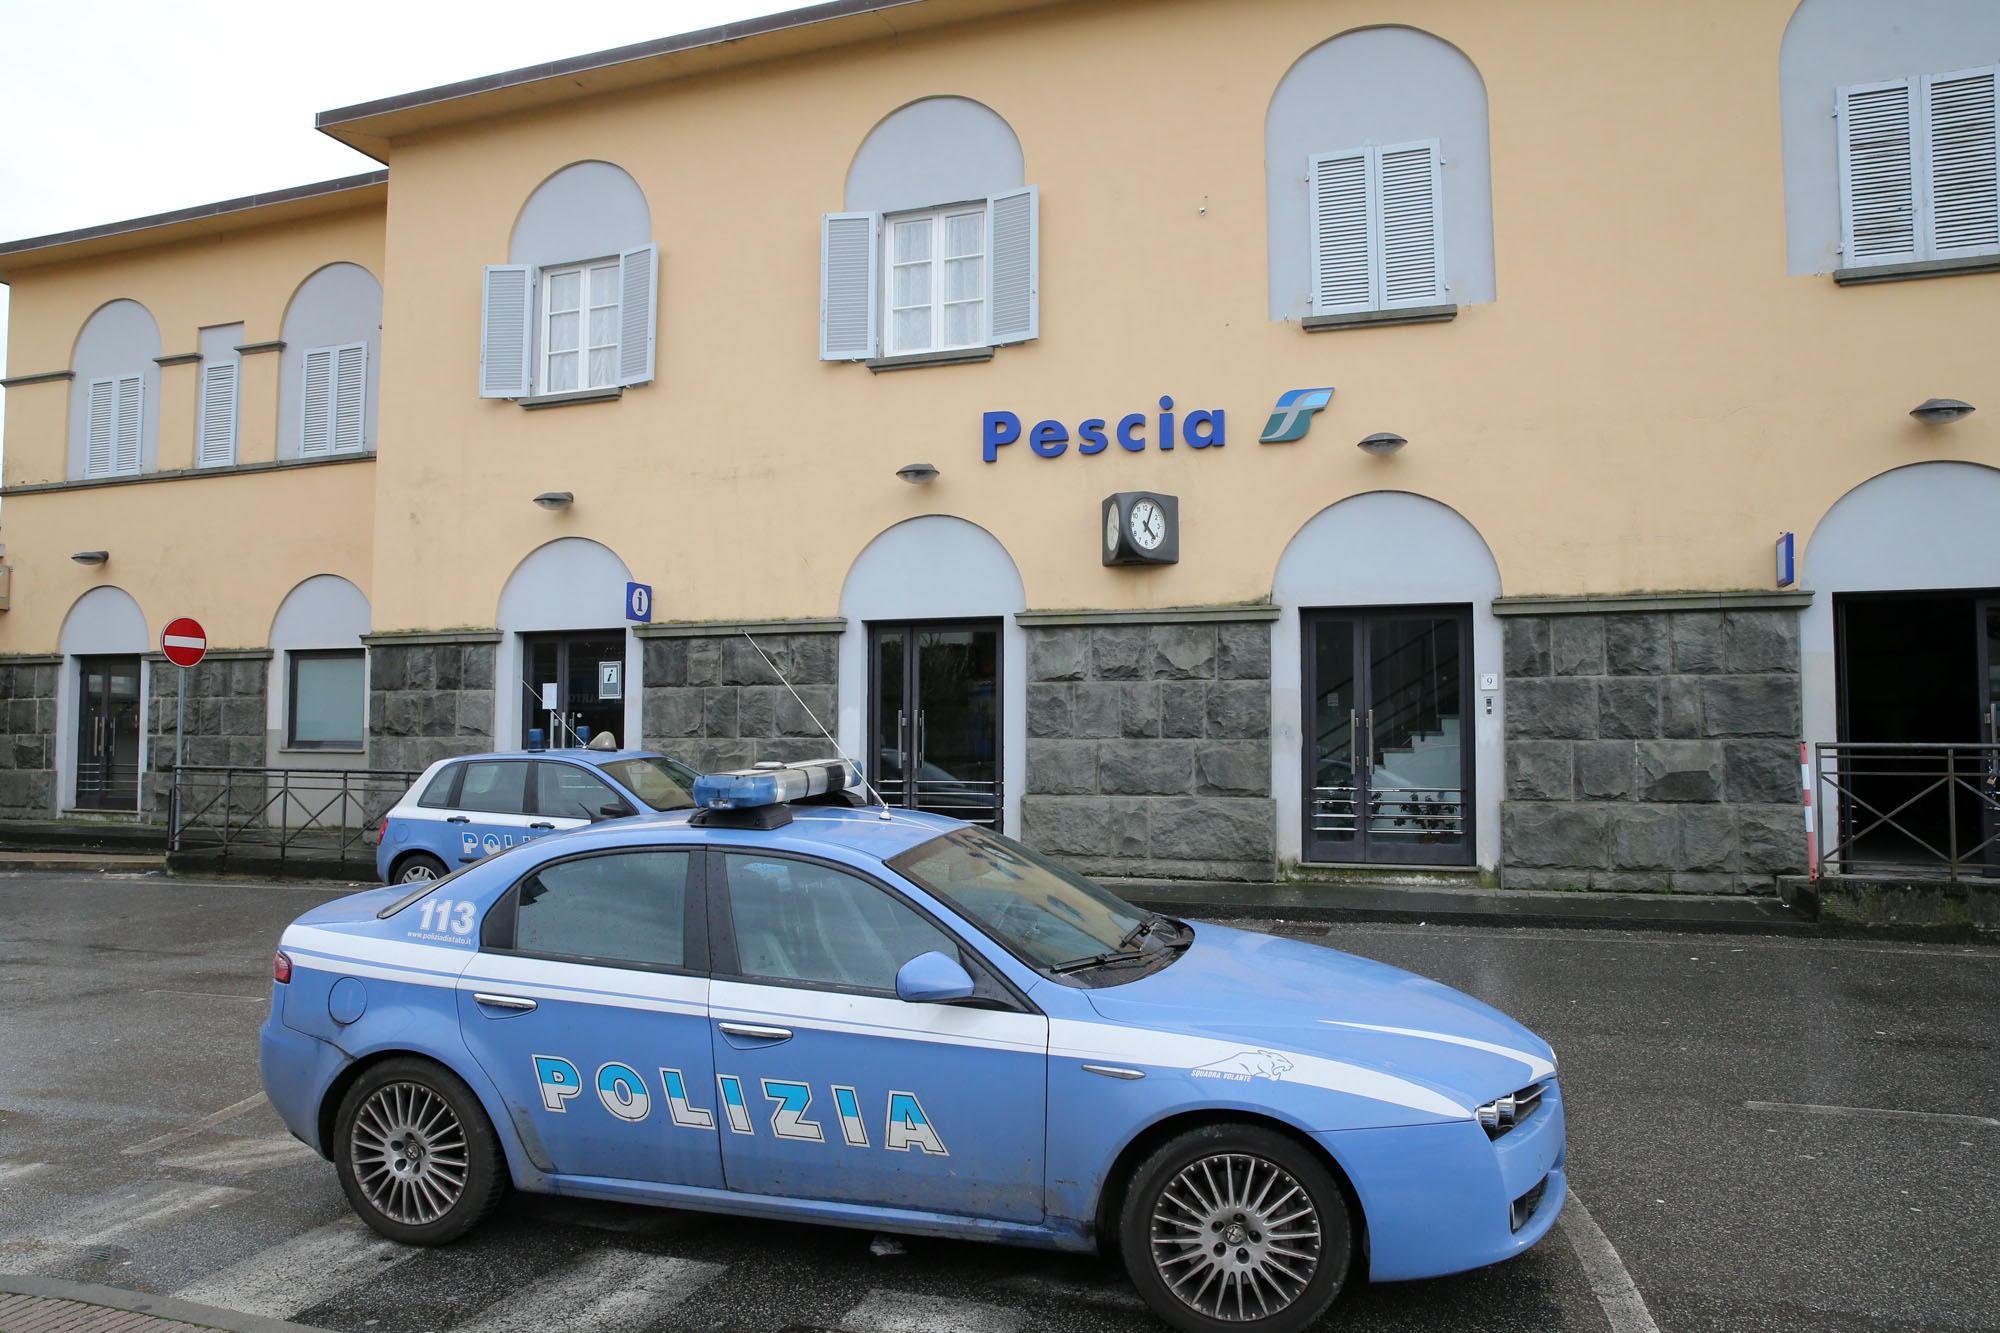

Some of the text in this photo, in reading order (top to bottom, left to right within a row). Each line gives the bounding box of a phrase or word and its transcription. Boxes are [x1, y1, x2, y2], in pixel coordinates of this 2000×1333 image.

[983, 395, 1225, 462] Pescia
[407, 931, 472, 945] www.poliziadistato.it
[419, 899, 477, 935] 113
[531, 1054, 950, 1156] POLIZIA
